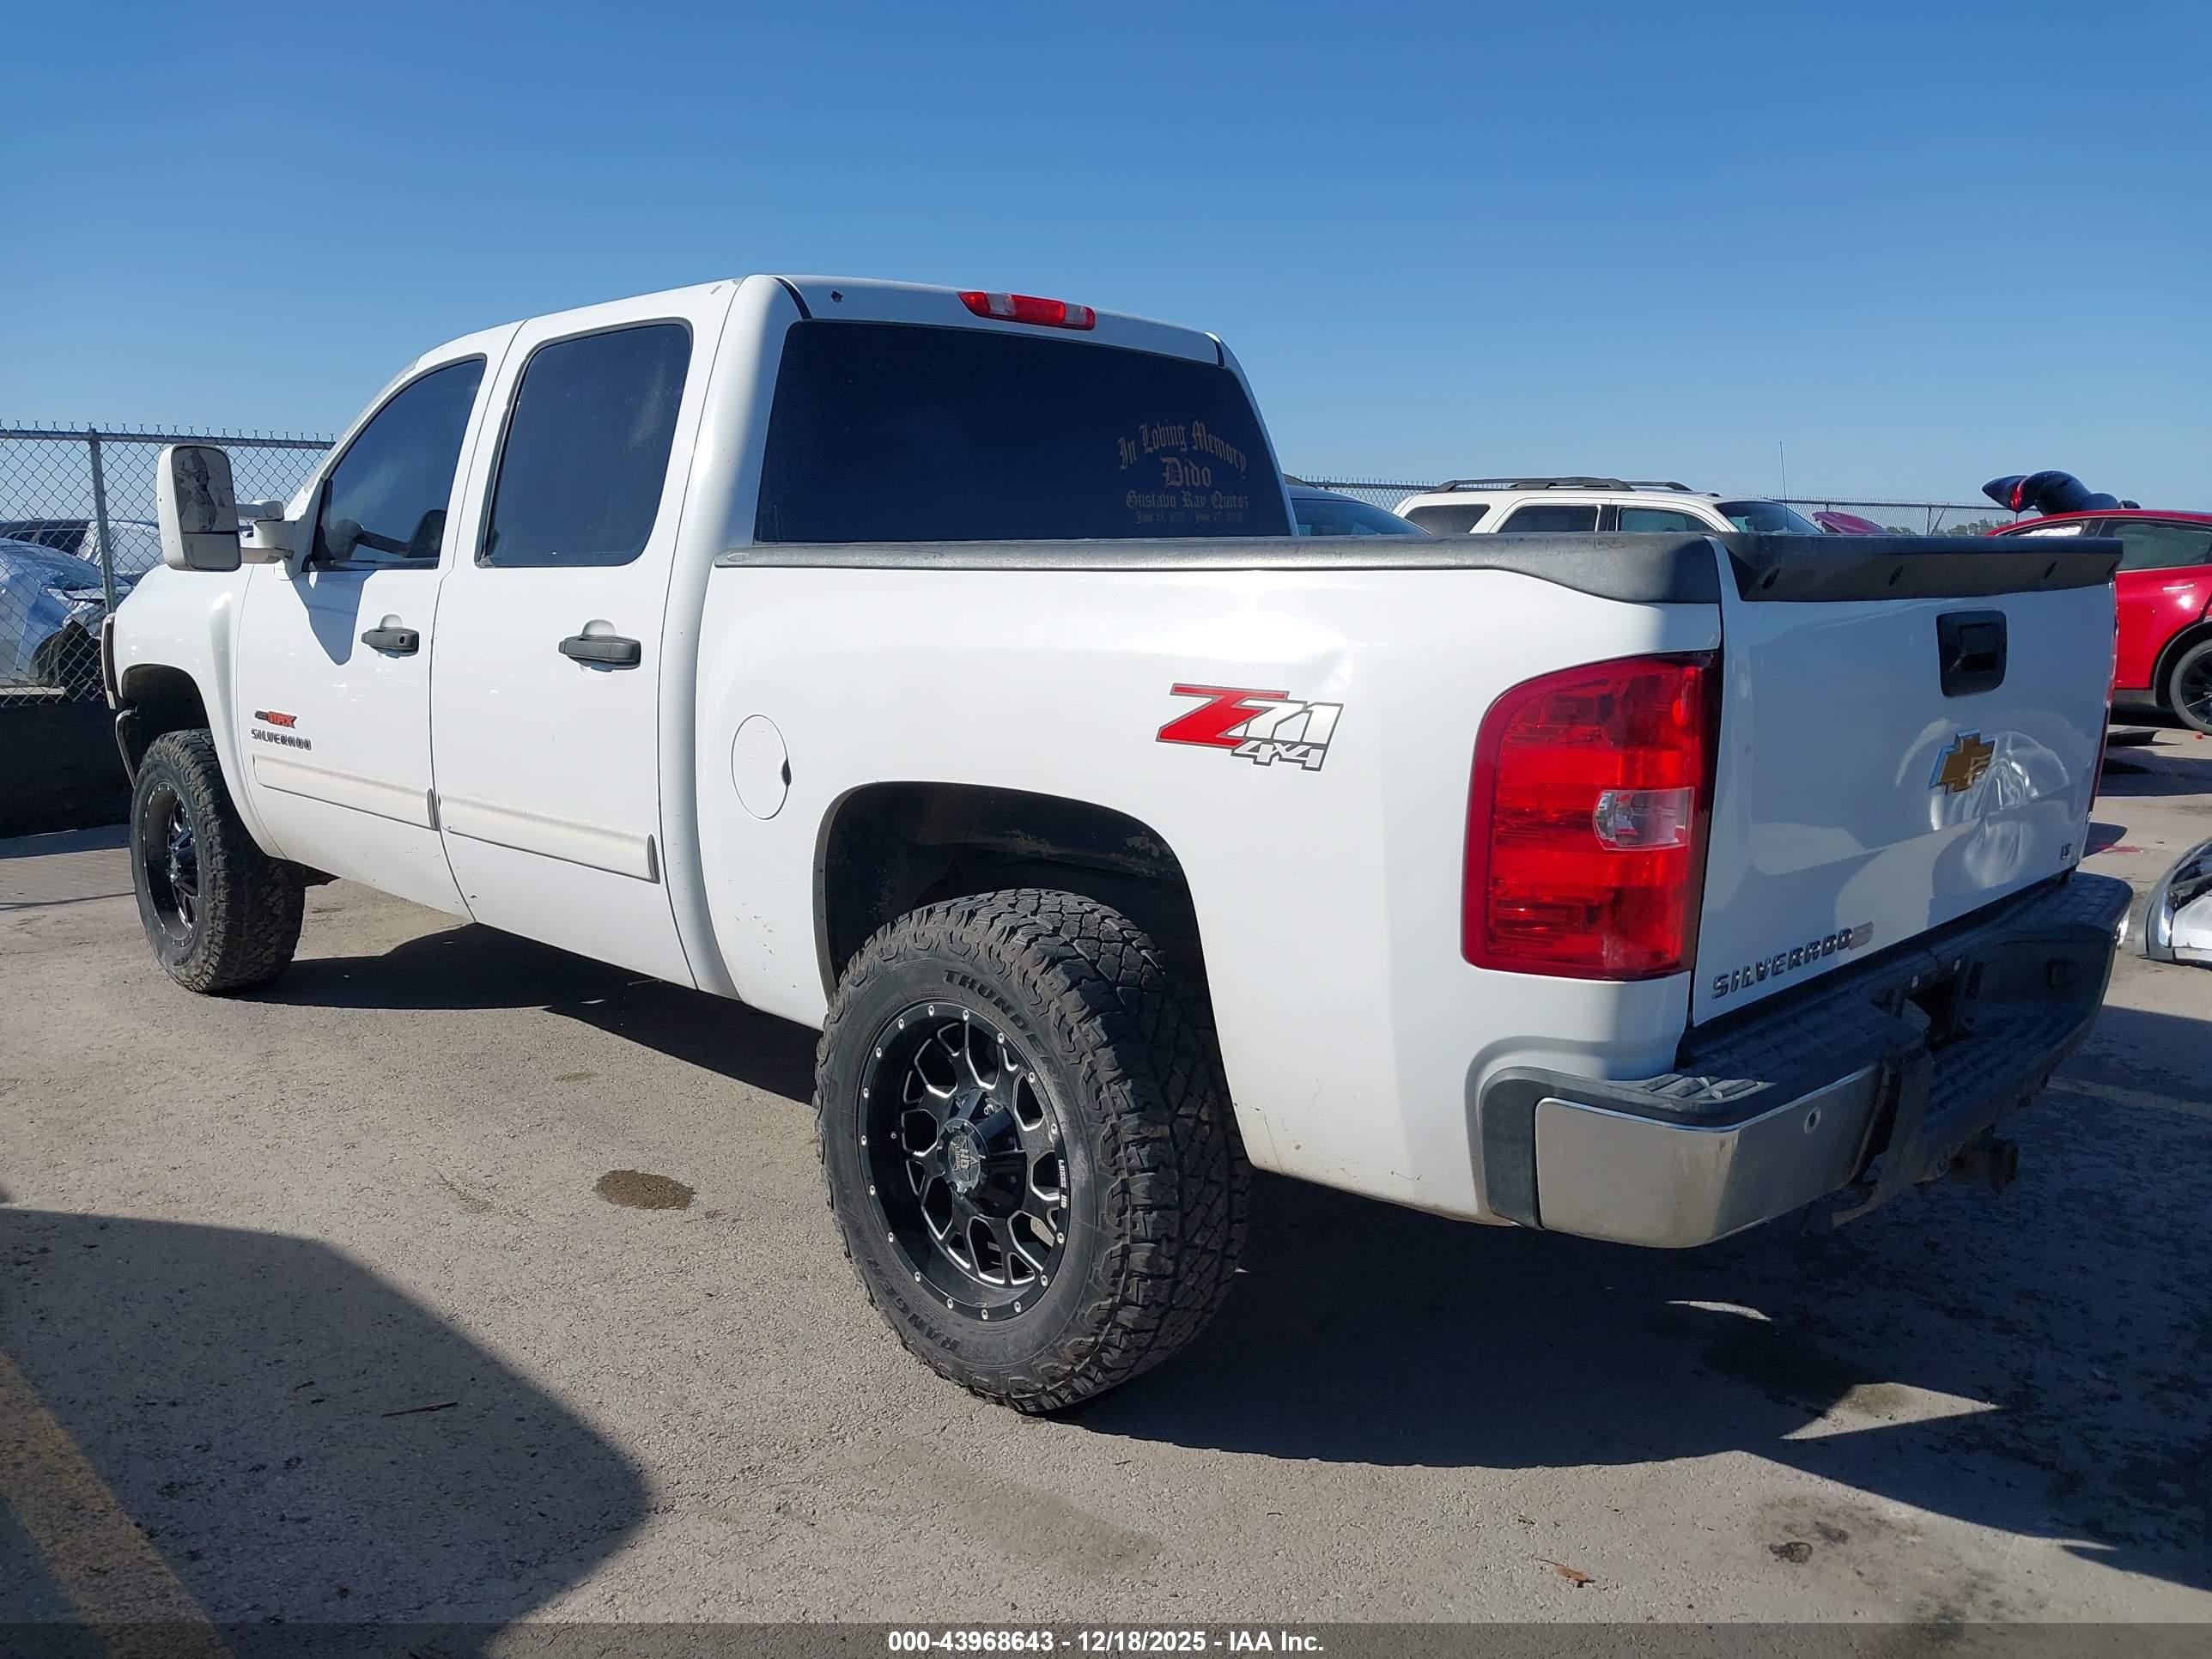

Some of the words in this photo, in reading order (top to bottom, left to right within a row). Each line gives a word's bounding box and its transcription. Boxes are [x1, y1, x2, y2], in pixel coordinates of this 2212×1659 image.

[1117, 437, 1137, 470] In
[1139, 419, 1188, 454] Loving
[1192, 420, 1247, 479] Memory
[1160, 456, 1212, 488] Dido
[1126, 489, 1176, 509] Gustavo
[1155, 683, 1345, 750] Z71
[1711, 927, 1853, 1000] SILVERADO
